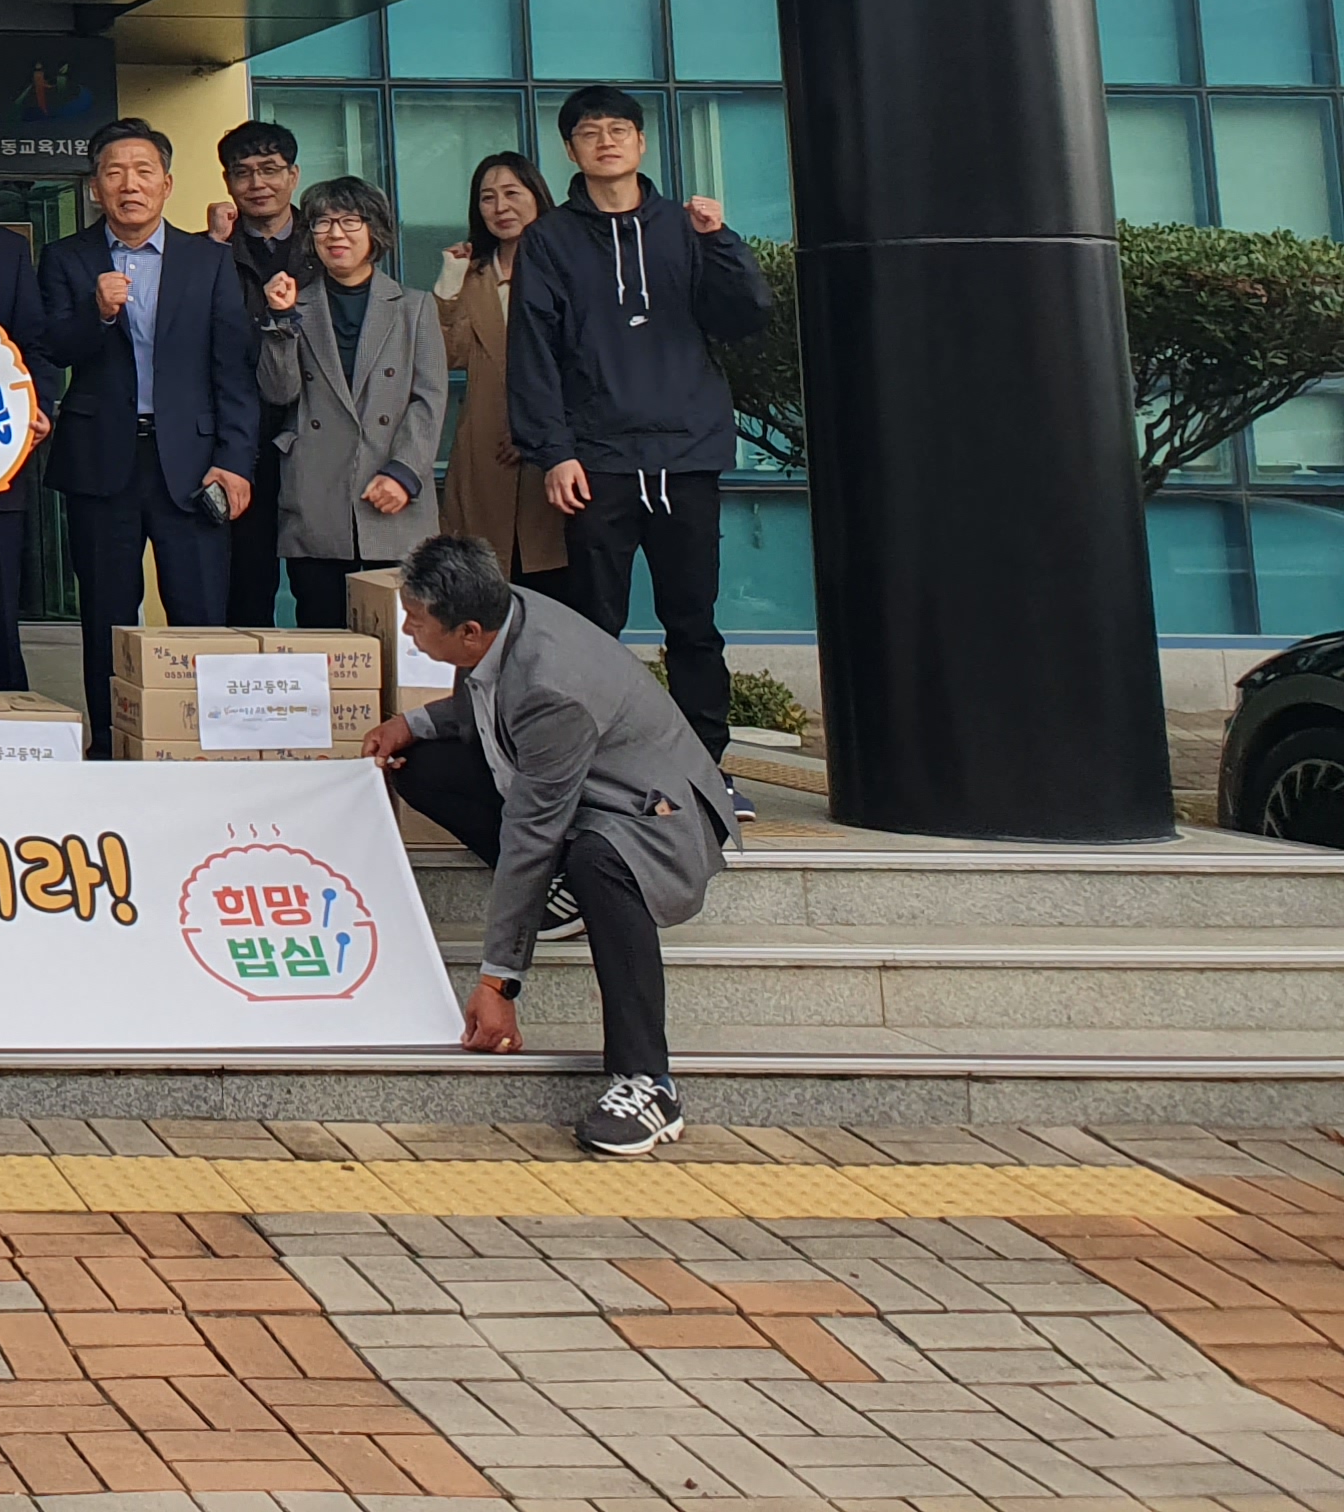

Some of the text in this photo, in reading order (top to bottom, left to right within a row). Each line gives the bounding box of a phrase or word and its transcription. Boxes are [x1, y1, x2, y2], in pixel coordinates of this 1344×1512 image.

[226, 680, 302, 694] 금남고등학교
[212, 884, 310, 927] 희망
[227, 935, 331, 978] 밥심
